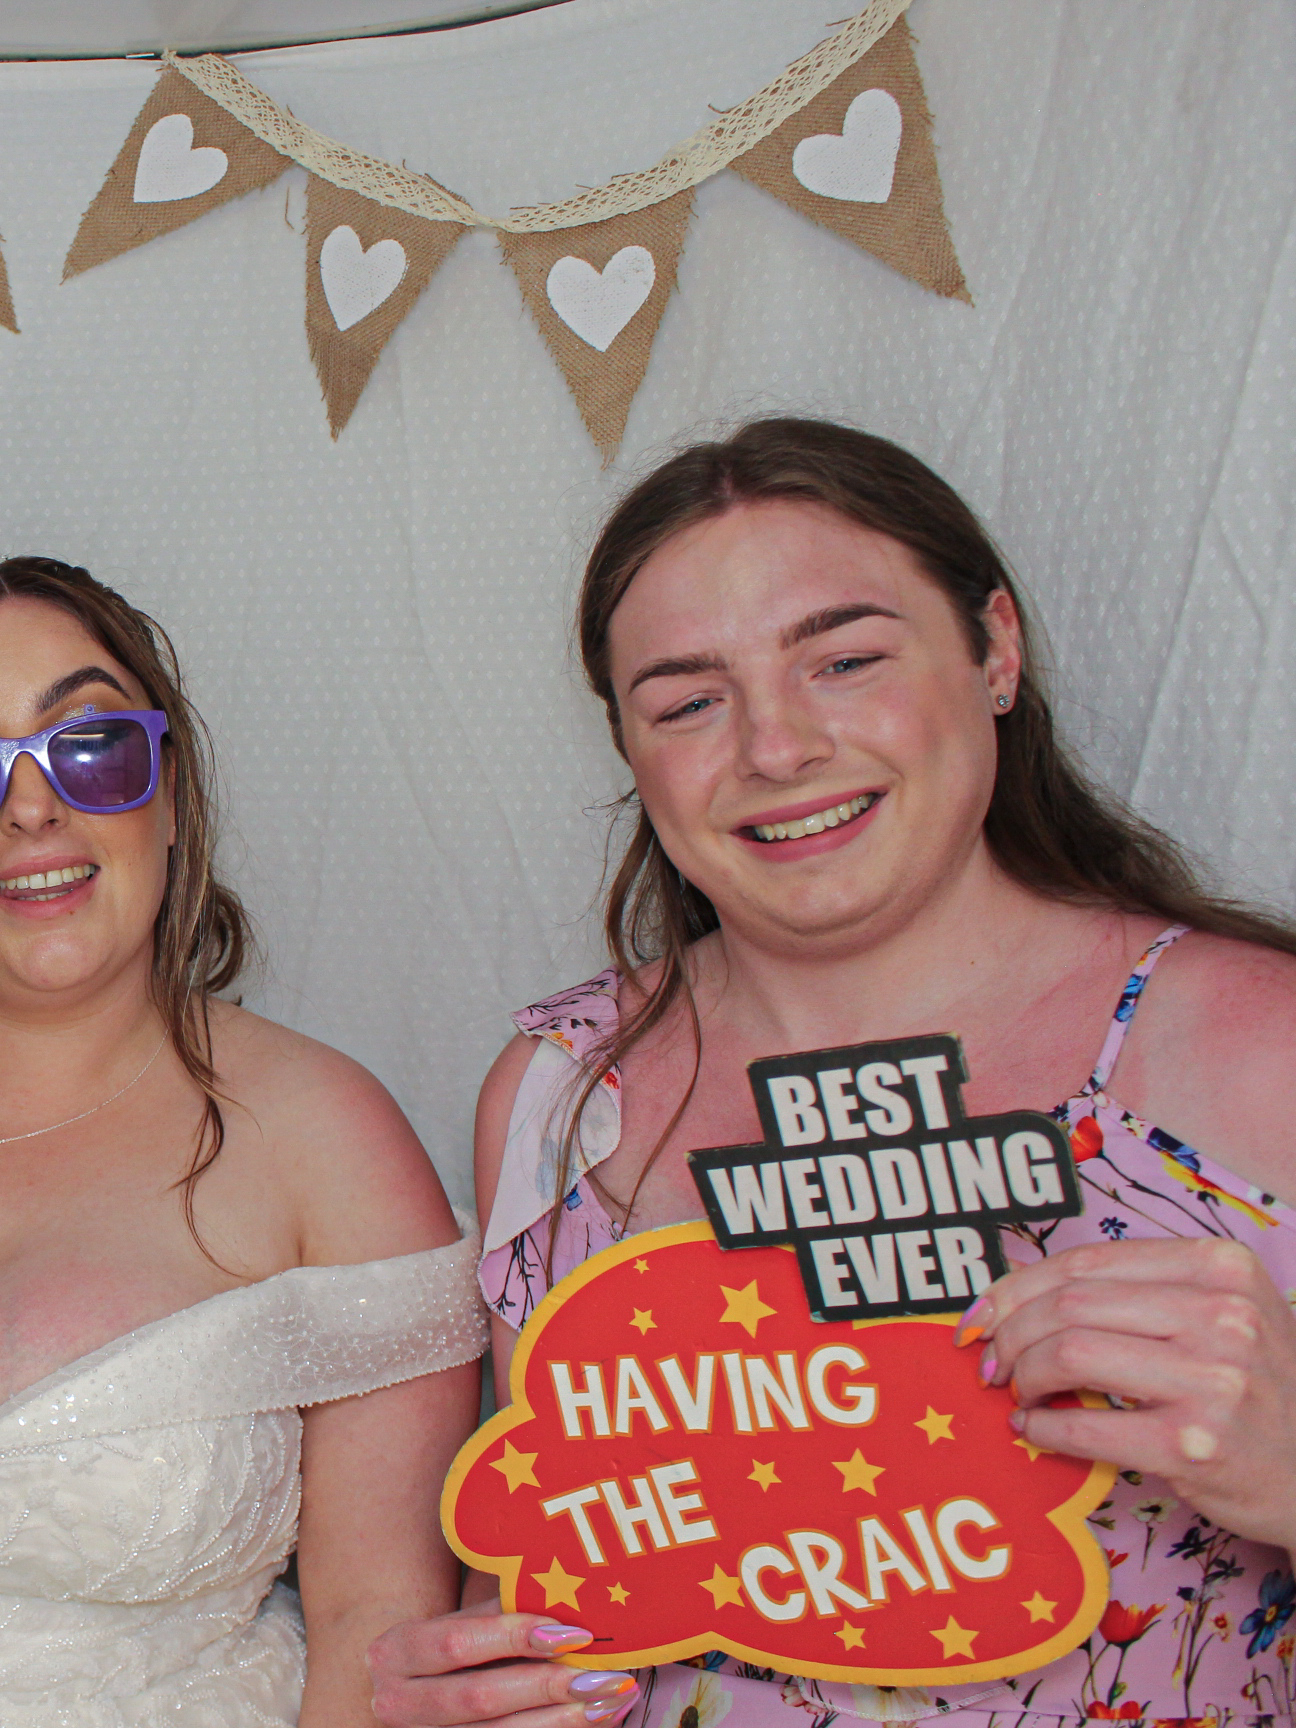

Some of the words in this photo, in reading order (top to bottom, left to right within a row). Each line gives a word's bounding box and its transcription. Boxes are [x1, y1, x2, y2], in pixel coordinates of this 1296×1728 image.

[767, 1055, 949, 1147] BEST
[707, 1131, 1064, 1235] WEDDING
[809, 1227, 992, 1307] EVER
[548, 1344, 878, 1438] HAVING
[541, 1459, 718, 1565] THE
[739, 1498, 1010, 1622] CRAIC
